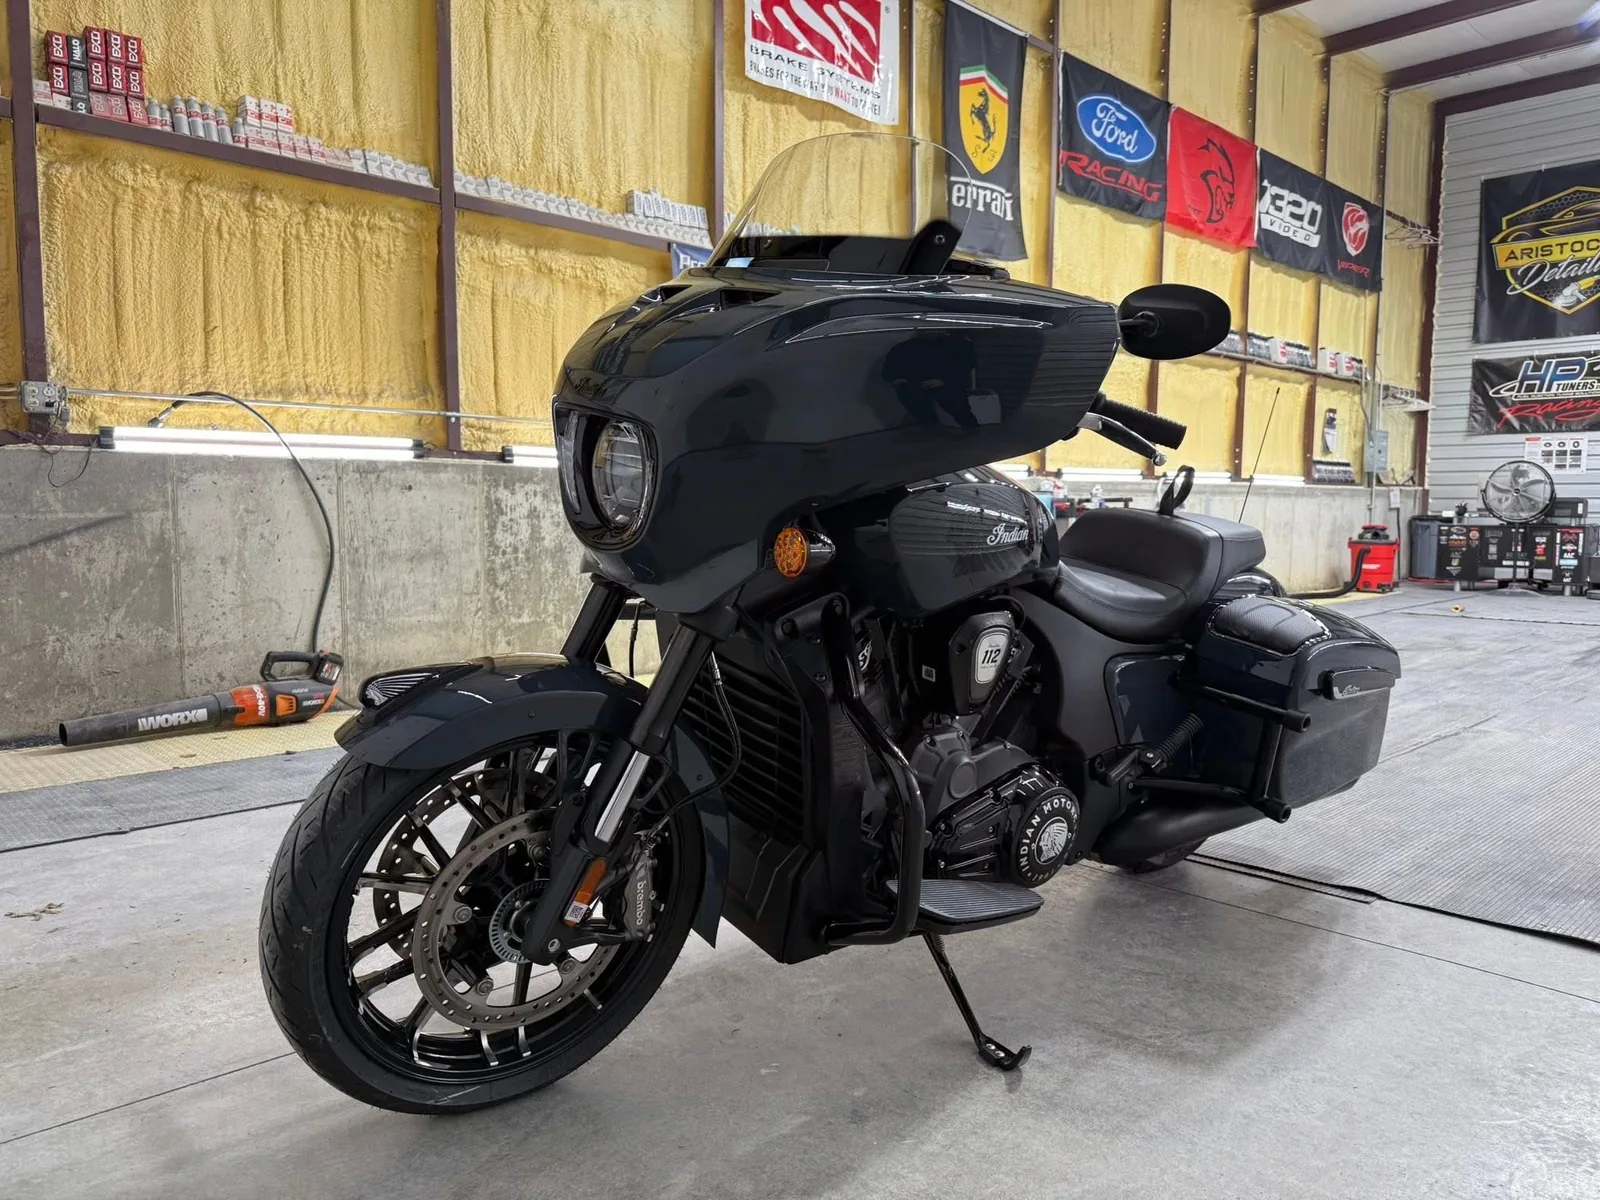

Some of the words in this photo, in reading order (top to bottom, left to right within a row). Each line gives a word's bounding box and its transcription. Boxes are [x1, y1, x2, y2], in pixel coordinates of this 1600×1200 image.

[750, 44, 808, 71] BRAKE
[816, 67, 881, 99] SYSTEMS
[790, 73, 801, 87] THE
[835, 86, 851, 105] WANT
[1091, 102, 1138, 154] Ford
[1059, 149, 1163, 202] RACING
[1269, 218, 1312, 242] VIDEO
[1337, 259, 1371, 279] VIPER
[1517, 356, 1588, 395] HP
[986, 522, 1030, 546] Indian
[981, 648, 1001, 665] 112
[138, 708, 208, 732] WORX
[1019, 814, 1042, 873] INDIAN
[636, 880, 647, 926] brembo
